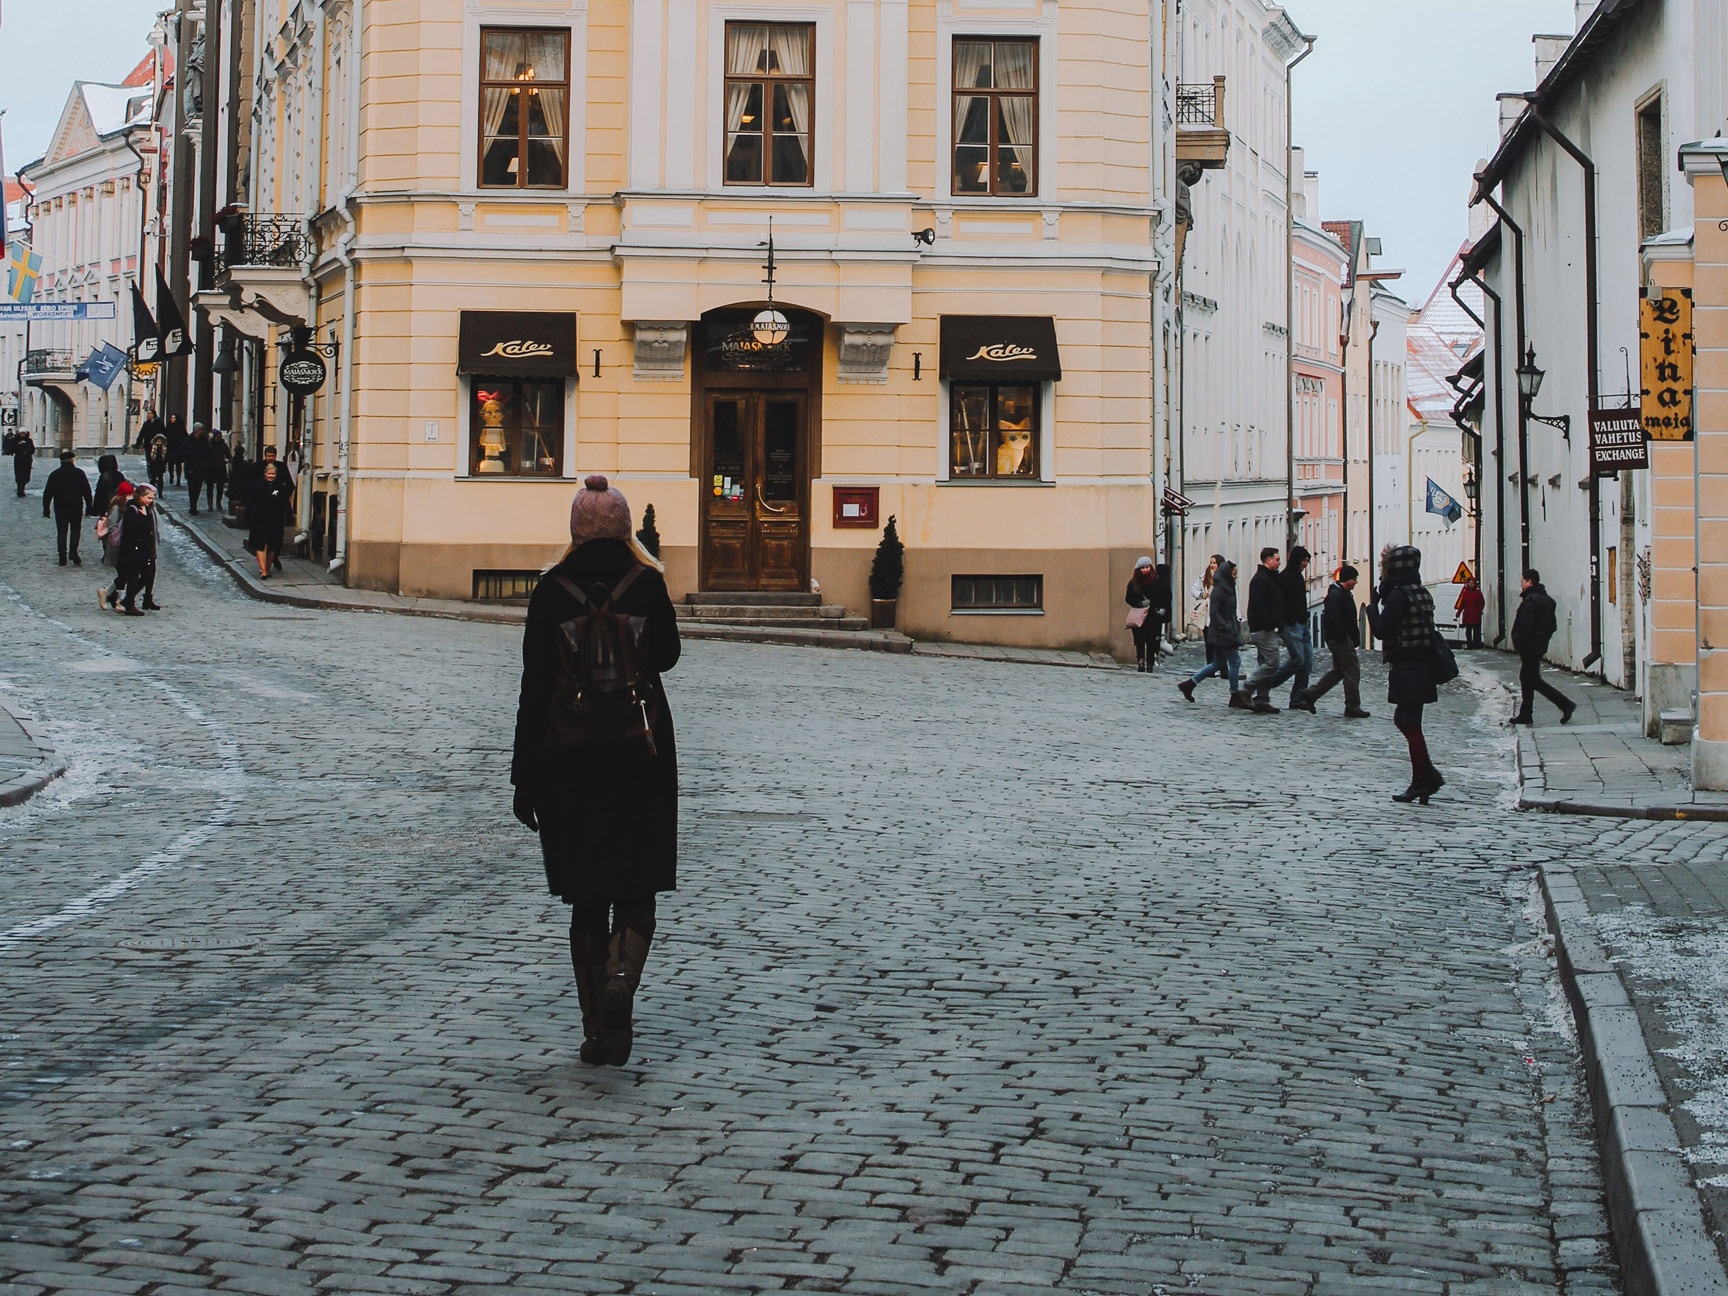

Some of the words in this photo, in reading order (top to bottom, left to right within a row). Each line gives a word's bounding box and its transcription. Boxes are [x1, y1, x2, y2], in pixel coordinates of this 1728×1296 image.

[480, 340, 554, 358] Kalev
[965, 344, 1037, 361] Kalev
[1595, 431, 1642, 444] VAHETUS
[1595, 448, 1645, 461] EXCHANGE
